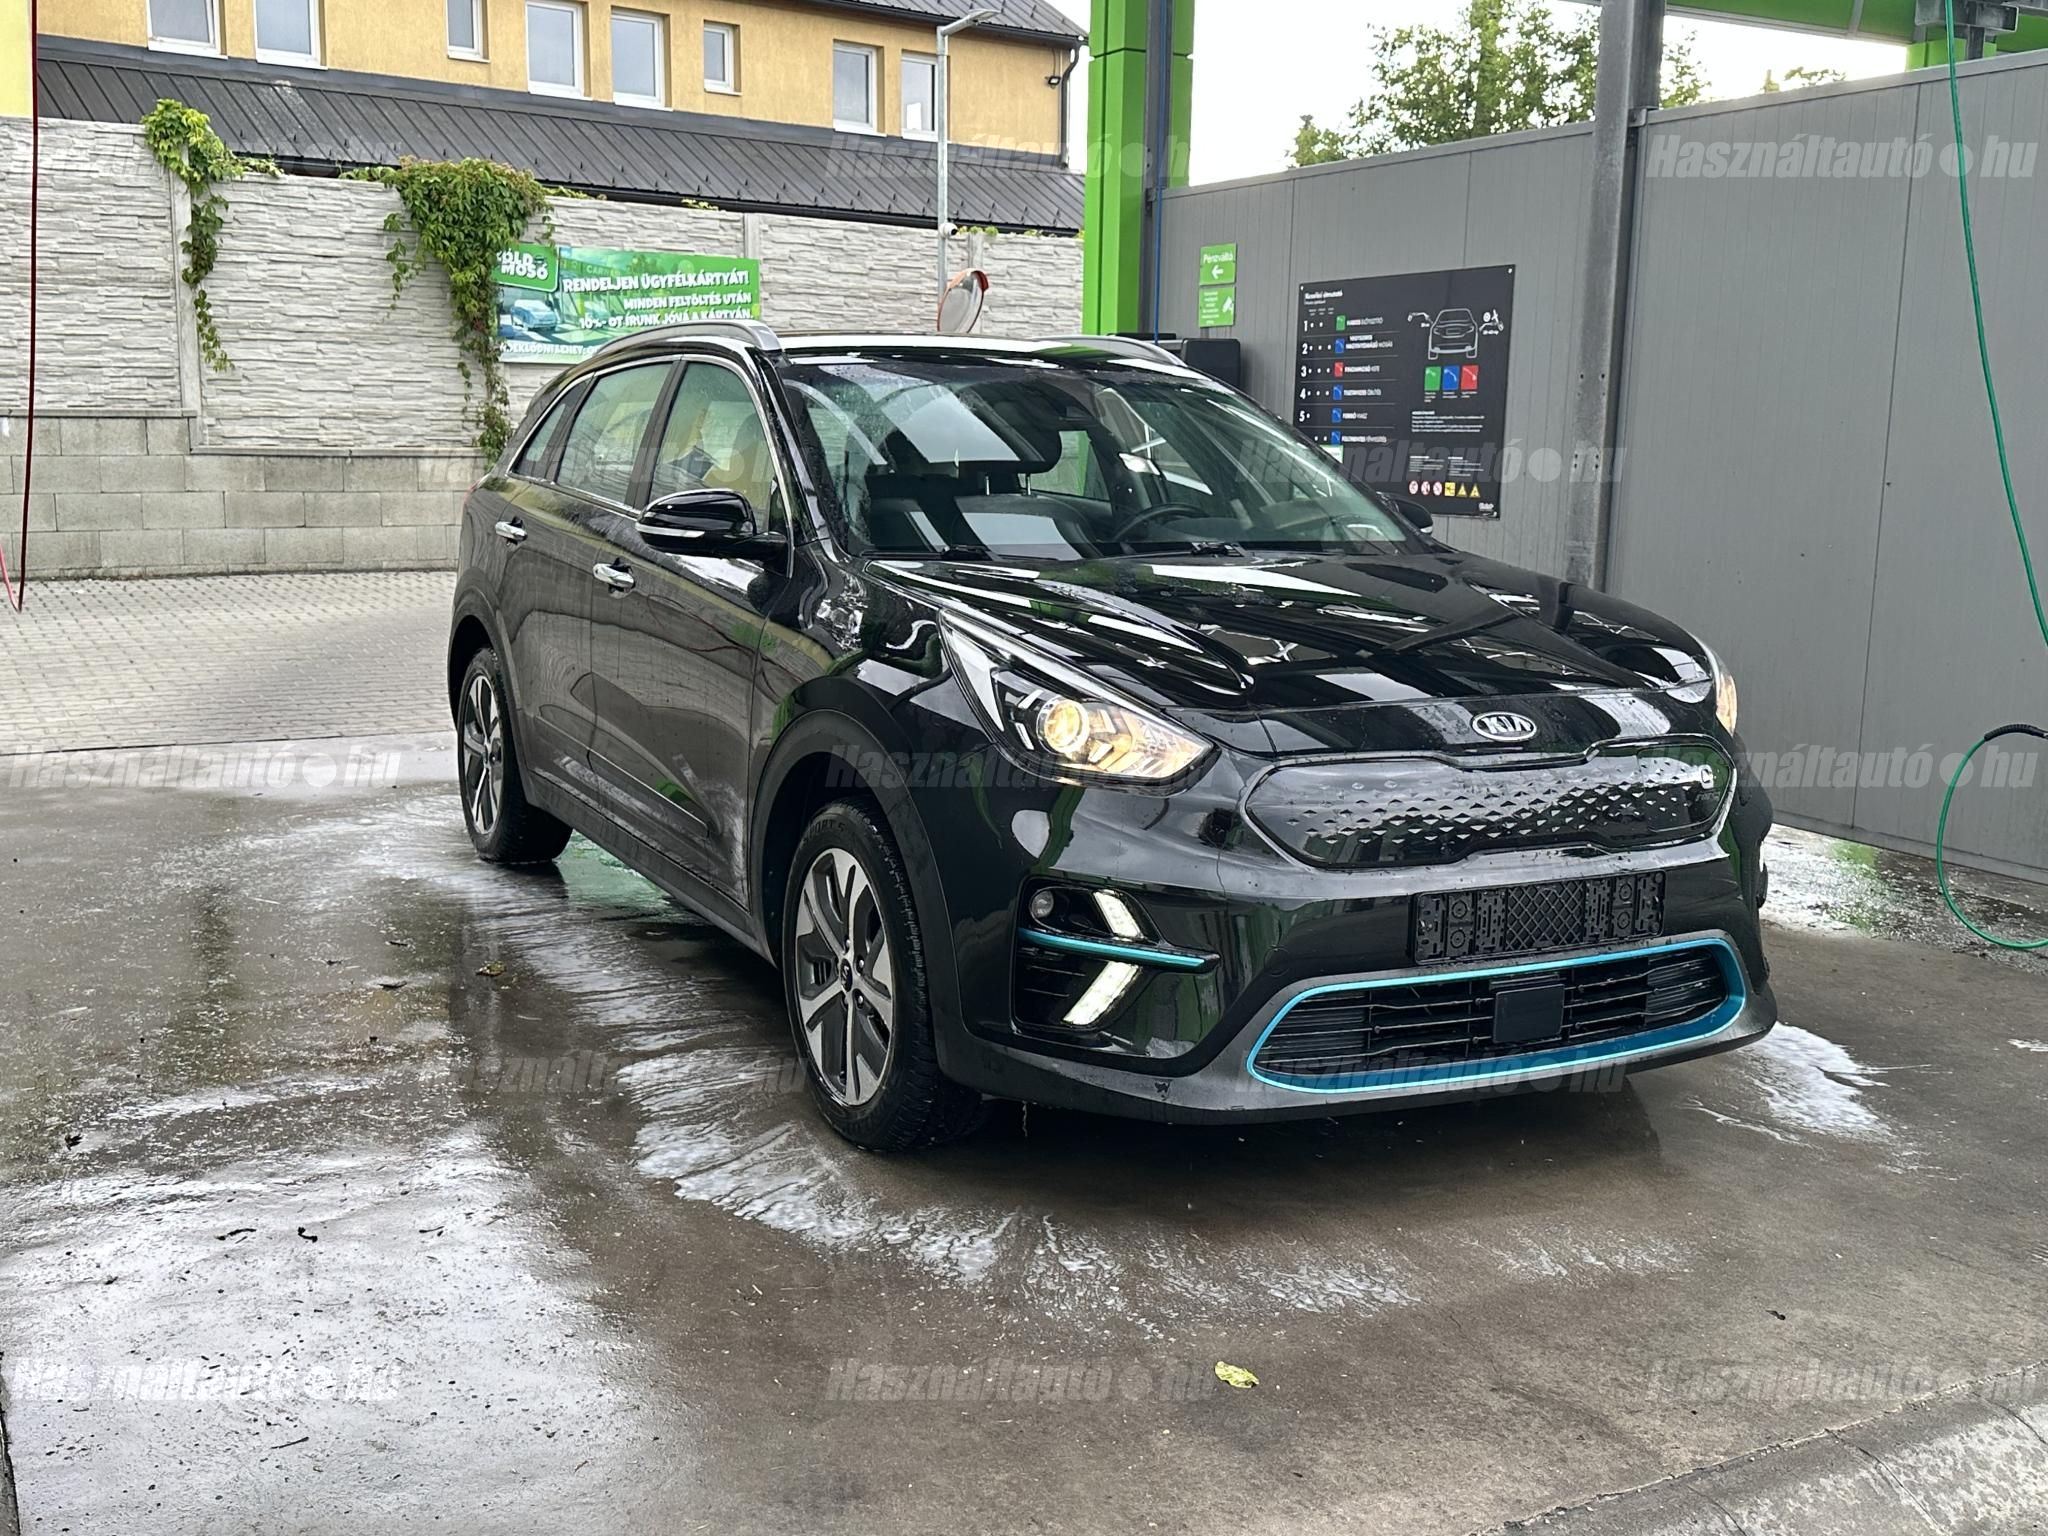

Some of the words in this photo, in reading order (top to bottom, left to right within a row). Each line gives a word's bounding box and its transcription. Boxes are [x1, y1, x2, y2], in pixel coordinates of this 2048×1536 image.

[501, 262, 548, 280] MOSÓ
[562, 276, 639, 293] RENDELJEN
[641, 267, 749, 289] ÜGYFÉLKÁRTYÁT!
[624, 296, 668, 310] MINDEN
[669, 293, 722, 308] FELTÖLTÉS
[724, 290, 752, 305] UTÁN
[1302, 343, 1308, 355] 2
[1301, 365, 1307, 377] 3
[1300, 387, 1306, 399] 4
[1299, 410, 1305, 422] 5
[1481, 716, 1531, 734] KIA
